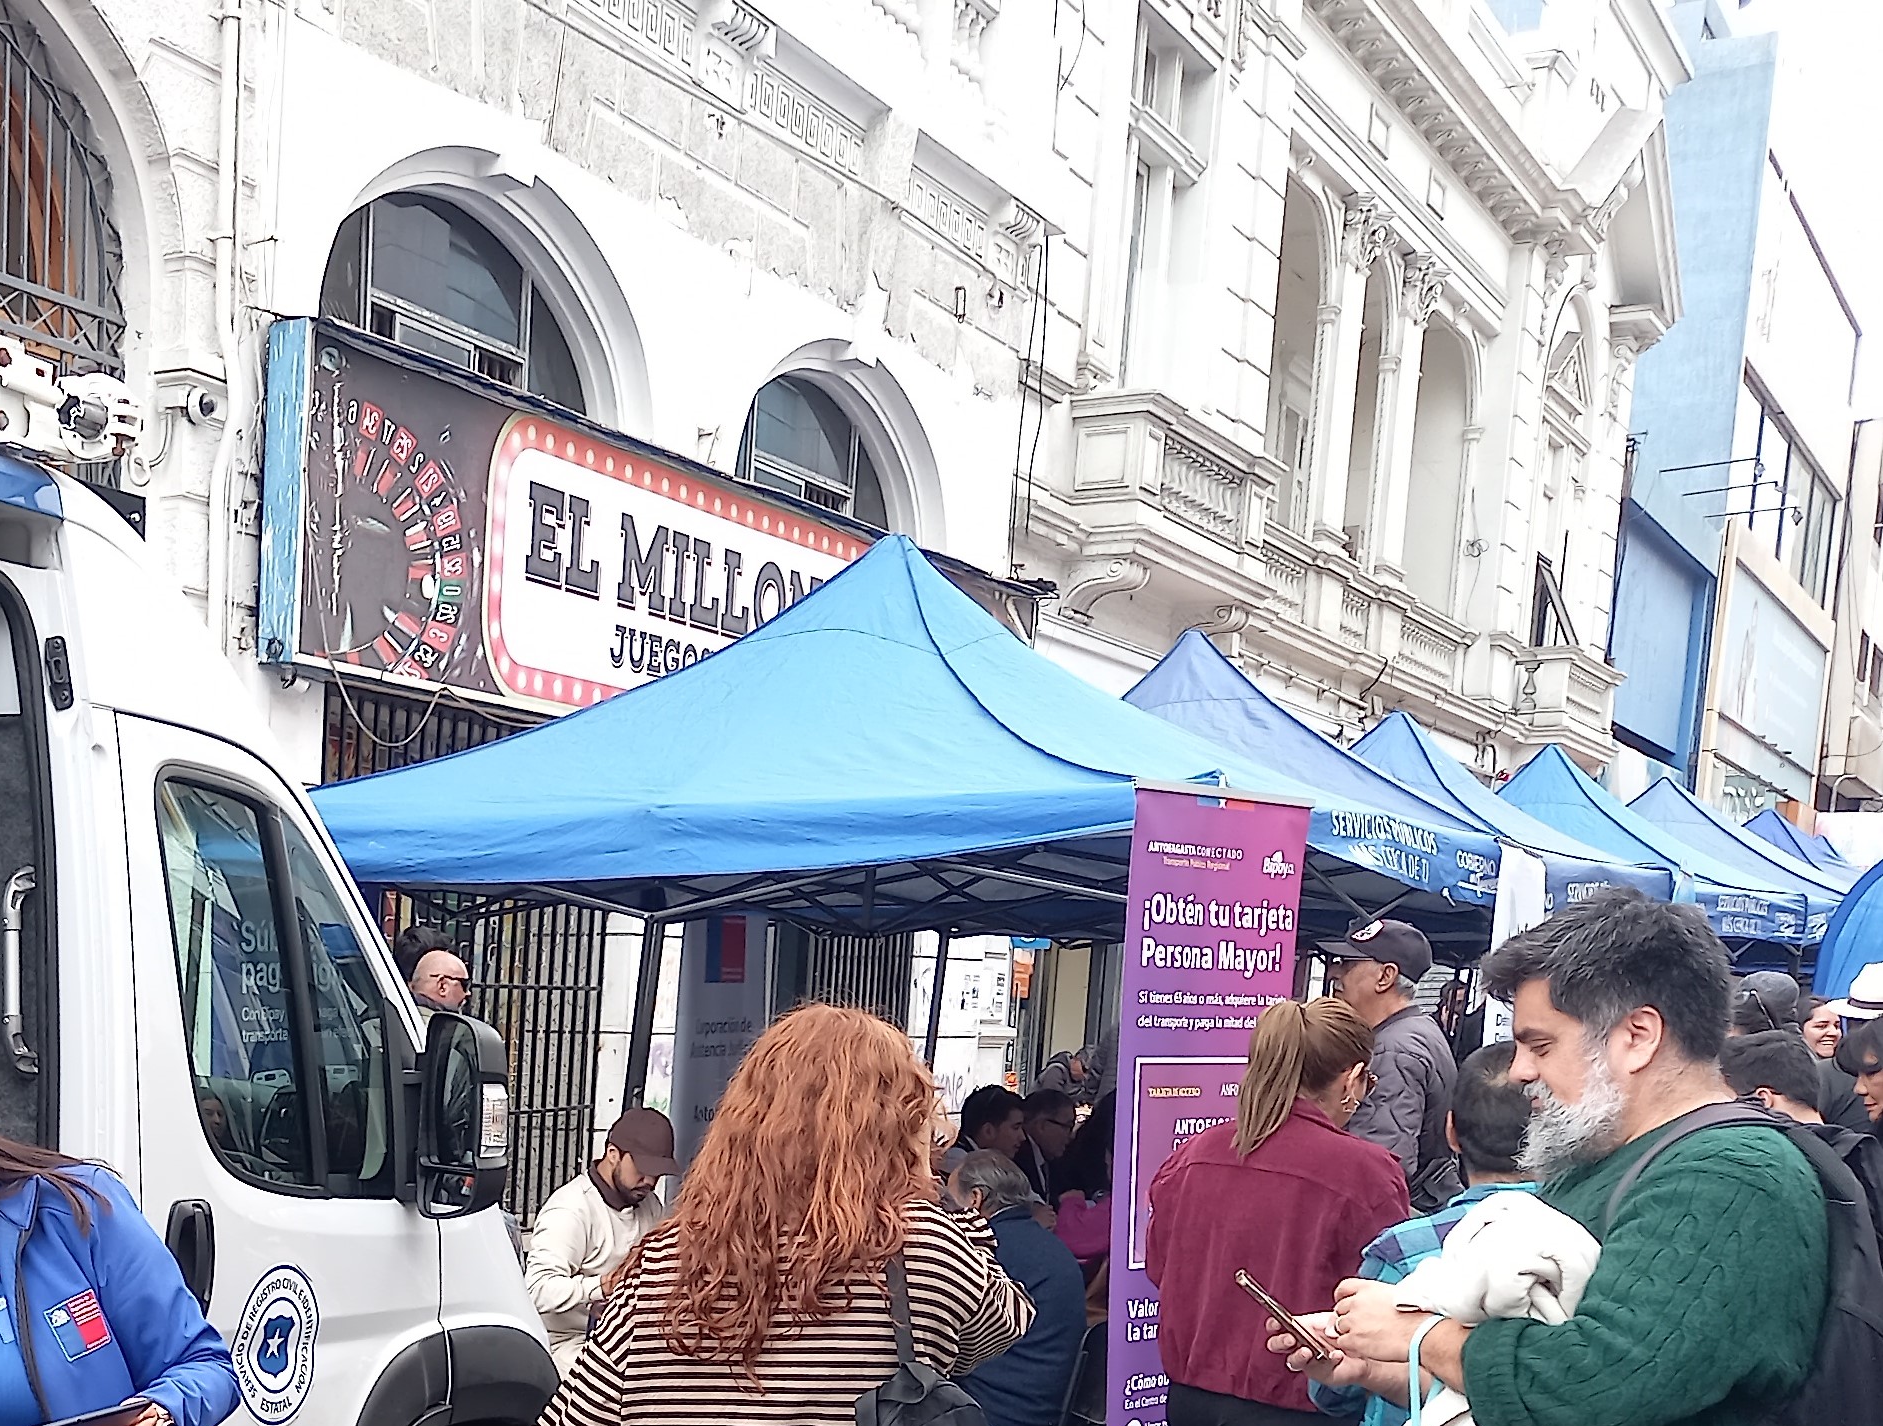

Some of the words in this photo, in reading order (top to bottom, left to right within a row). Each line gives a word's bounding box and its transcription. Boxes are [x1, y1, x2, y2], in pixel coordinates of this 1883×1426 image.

[525, 481, 601, 601] EL
[1143, 893, 1204, 930] ¡Obtén
[1208, 900, 1231, 927] tu
[1233, 899, 1294, 936] tarjeta
[1141, 938, 1213, 970] Persona
[1217, 941, 1283, 979] Mayor!
[1127, 1299, 1160, 1319] Valor
[1127, 1322, 1140, 1342] la
[260, 1396, 293, 1414] ESTATAL
